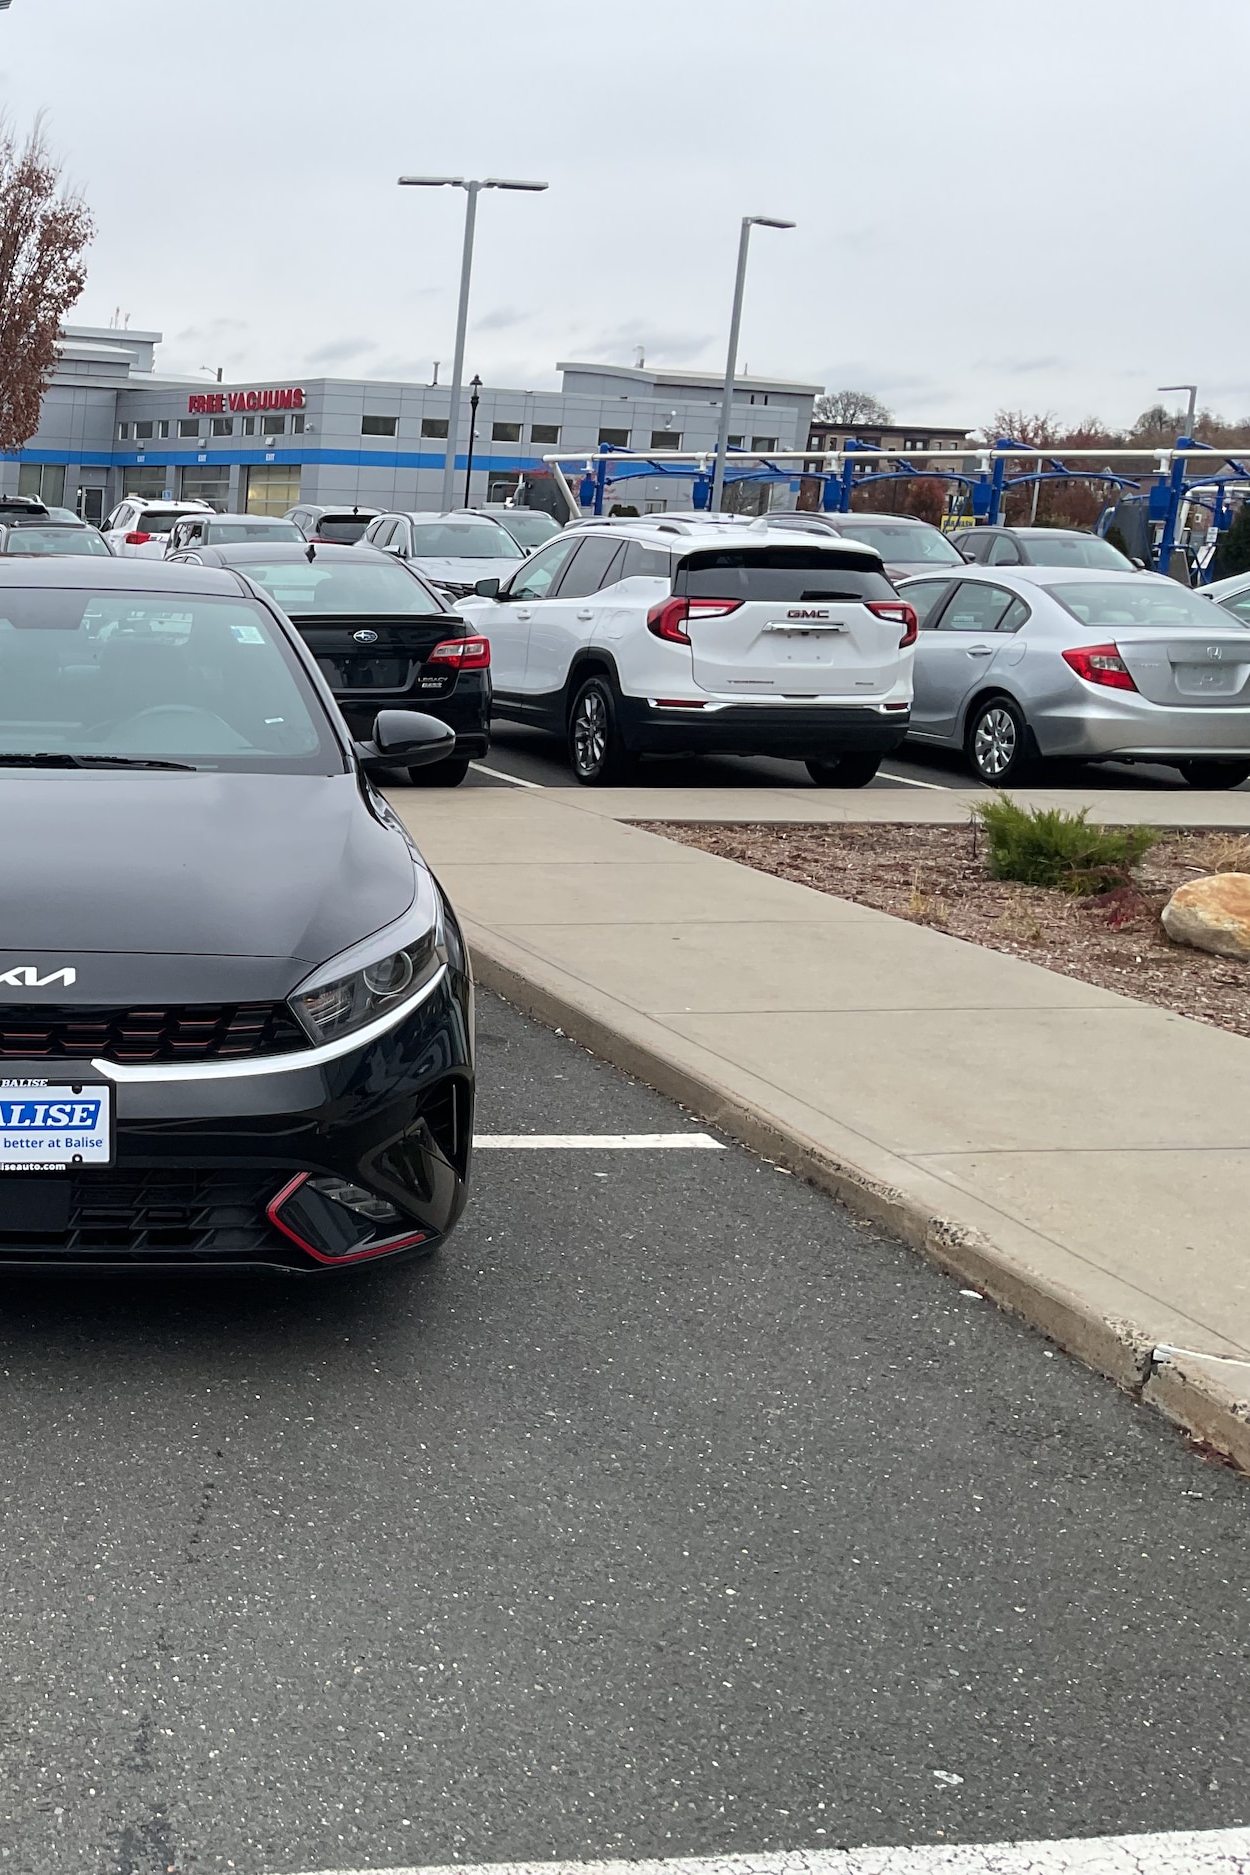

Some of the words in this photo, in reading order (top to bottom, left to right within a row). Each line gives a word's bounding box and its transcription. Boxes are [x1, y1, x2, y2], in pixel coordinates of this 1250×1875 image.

[188, 394, 225, 413] FREE
[228, 388, 306, 411] VACUUMS
[787, 609, 830, 619] GMC
[1, 1078, 49, 1088] BALISE
[3, 1138, 44, 1148] better
[47, 1138, 61, 1148] at
[65, 1137, 103, 1148] Balise
